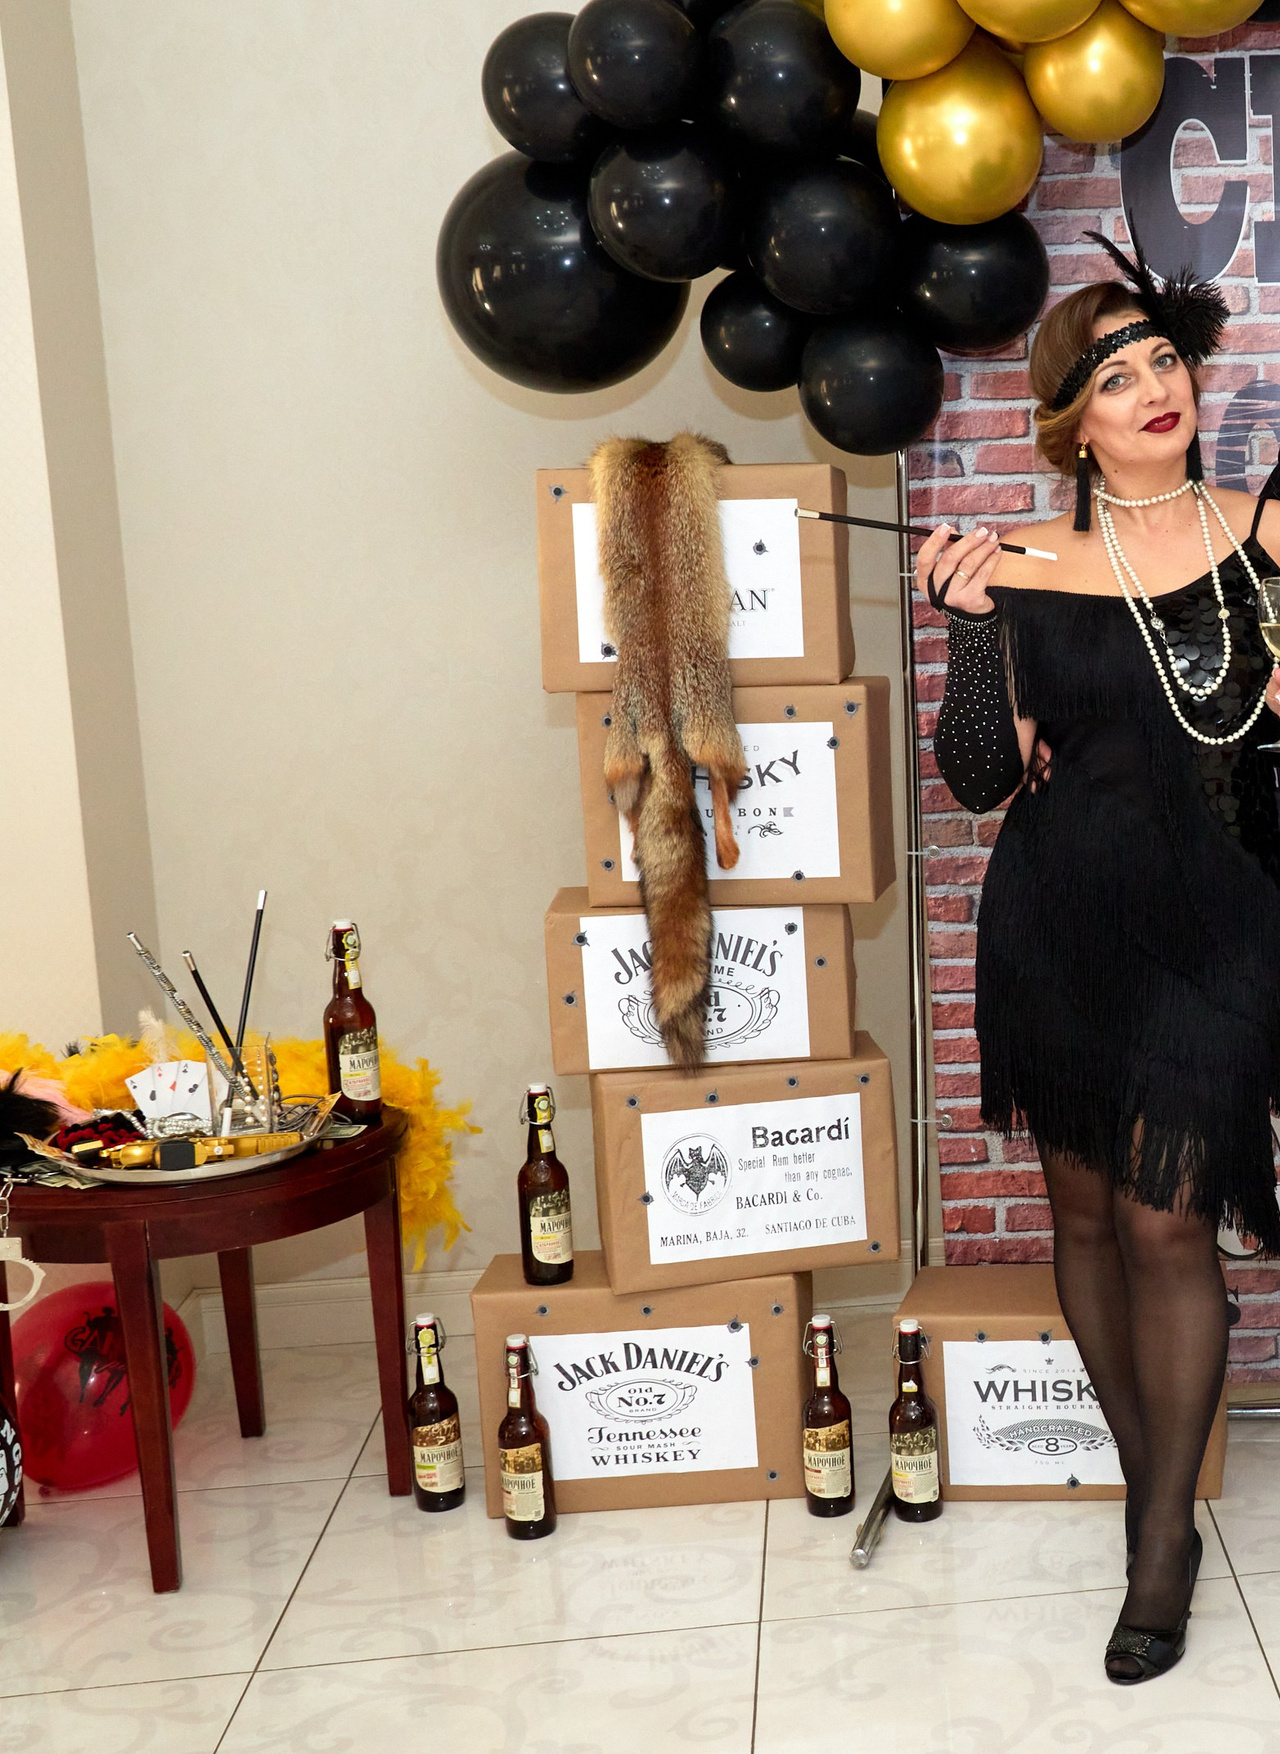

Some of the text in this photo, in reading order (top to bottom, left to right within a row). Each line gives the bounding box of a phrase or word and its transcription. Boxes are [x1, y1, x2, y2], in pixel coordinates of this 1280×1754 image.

[729, 589, 768, 611] AN
[611, 932, 783, 985] JAC NIEL'S
[751, 1117, 850, 1149] Bacardí
[738, 1156, 766, 1171] Special
[772, 1154, 789, 1168] Rum
[784, 1171, 801, 1183] than
[806, 1171, 819, 1182] any
[736, 1191, 788, 1210] BACARDI
[792, 1190, 801, 1203] &
[660, 1233, 702, 1248] MARINA,
[765, 1219, 812, 1235] SANTIAGO
[815, 1218, 829, 1229] DE
[831, 1215, 856, 1227] CUBA
[553, 1342, 730, 1392] JACK DANIEL'S
[628, 1386, 653, 1395] Old
[973, 1379, 1099, 1403] WHISK
[587, 1426, 702, 1445] Tennessee
[1009, 1424, 1093, 1439] HANDCRAFTED
[616, 1444, 643, 1452] SOUR
[1045, 1437, 1059, 1452] 8
[591, 1449, 702, 1467] WHISKEY
